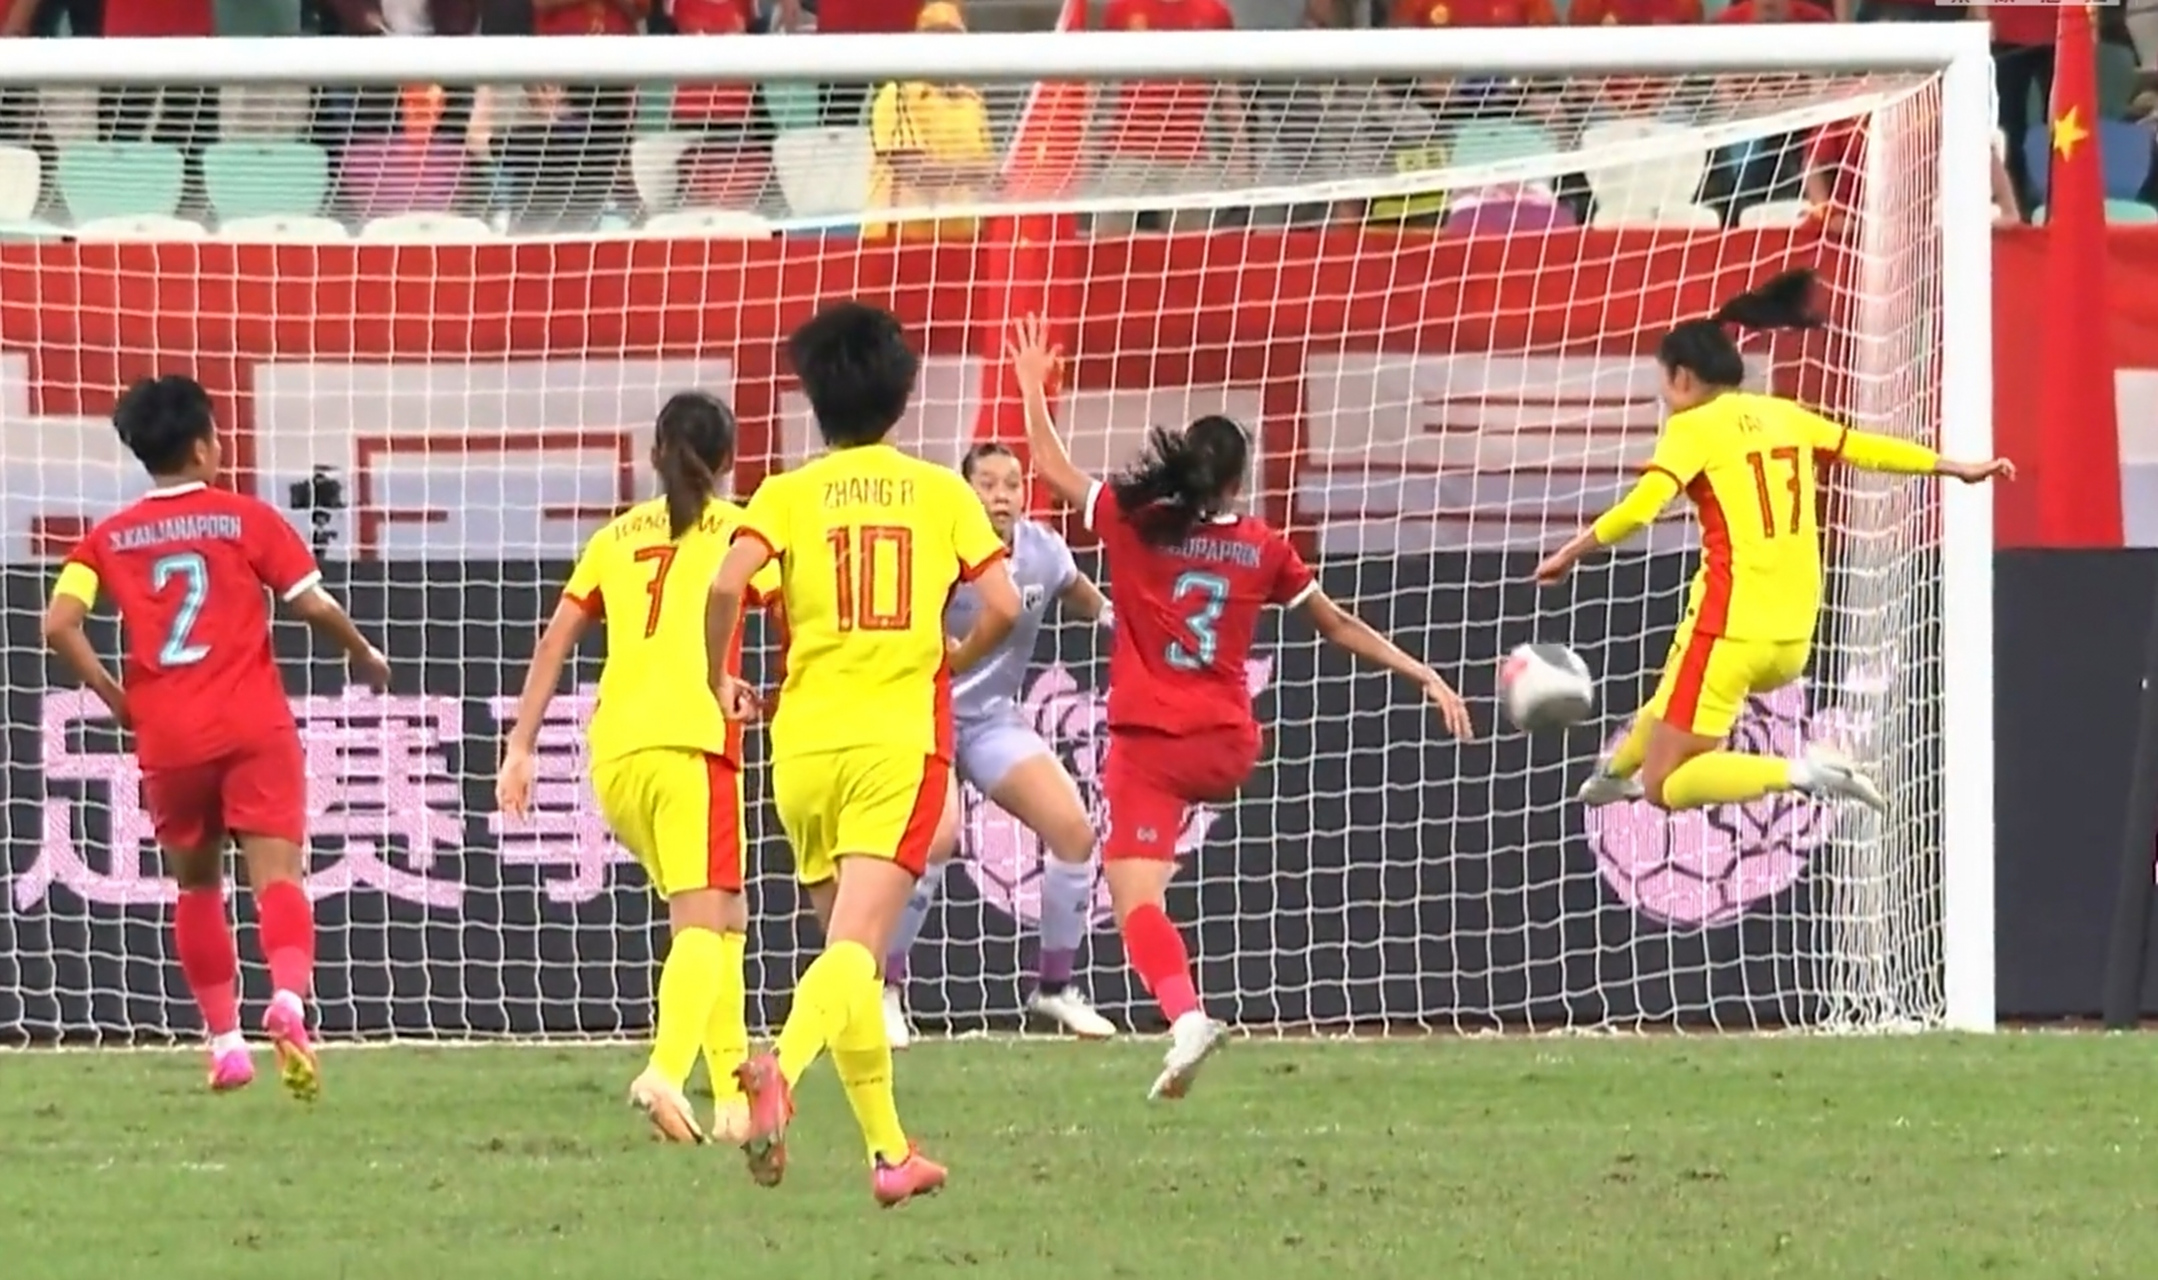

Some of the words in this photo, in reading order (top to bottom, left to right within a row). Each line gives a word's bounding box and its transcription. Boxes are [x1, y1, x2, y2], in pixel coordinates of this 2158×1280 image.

[823, 477, 893, 509] ZHANG
[1746, 446, 1800, 538] 17
[152, 550, 211, 667] 2
[634, 546, 678, 638] 7
[826, 525, 912, 632] 10
[1165, 571, 1230, 671] 3
